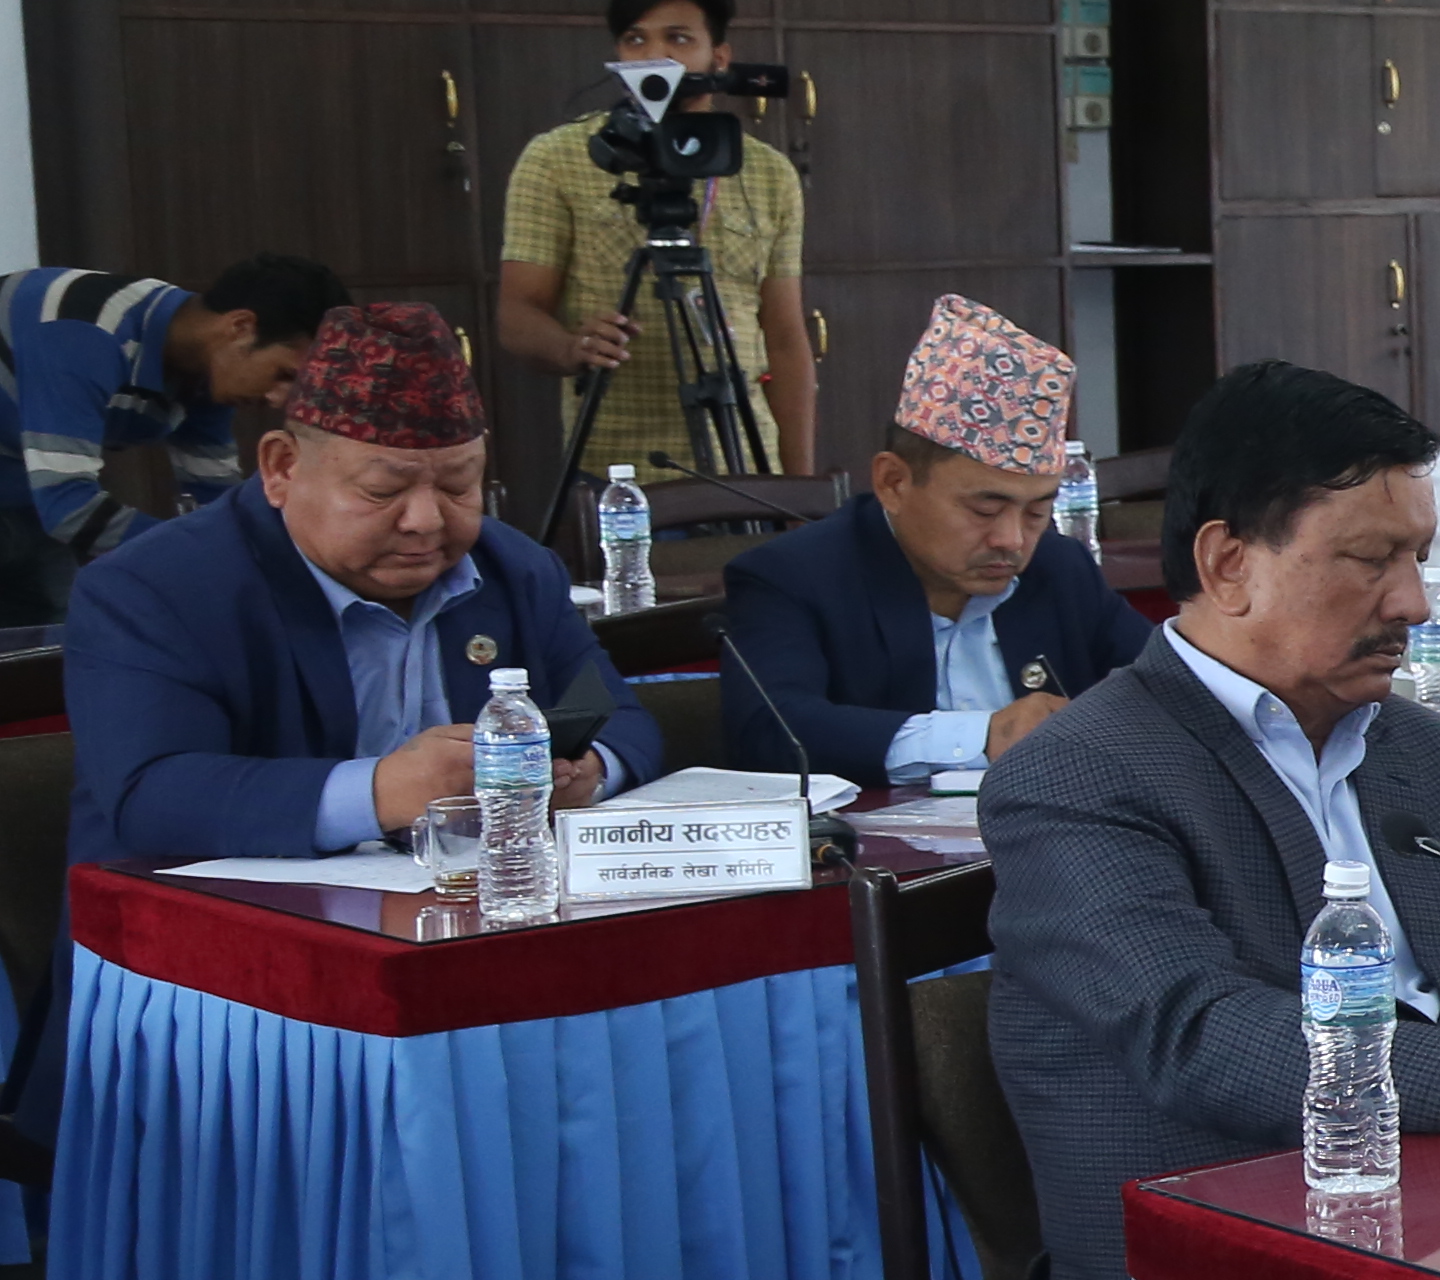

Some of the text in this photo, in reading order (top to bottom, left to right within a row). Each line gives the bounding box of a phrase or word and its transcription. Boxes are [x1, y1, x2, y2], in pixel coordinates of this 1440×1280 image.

[578, 819, 674, 845] माननीय
[598, 859, 774, 882] सार्वजनिक लेखा समिति
